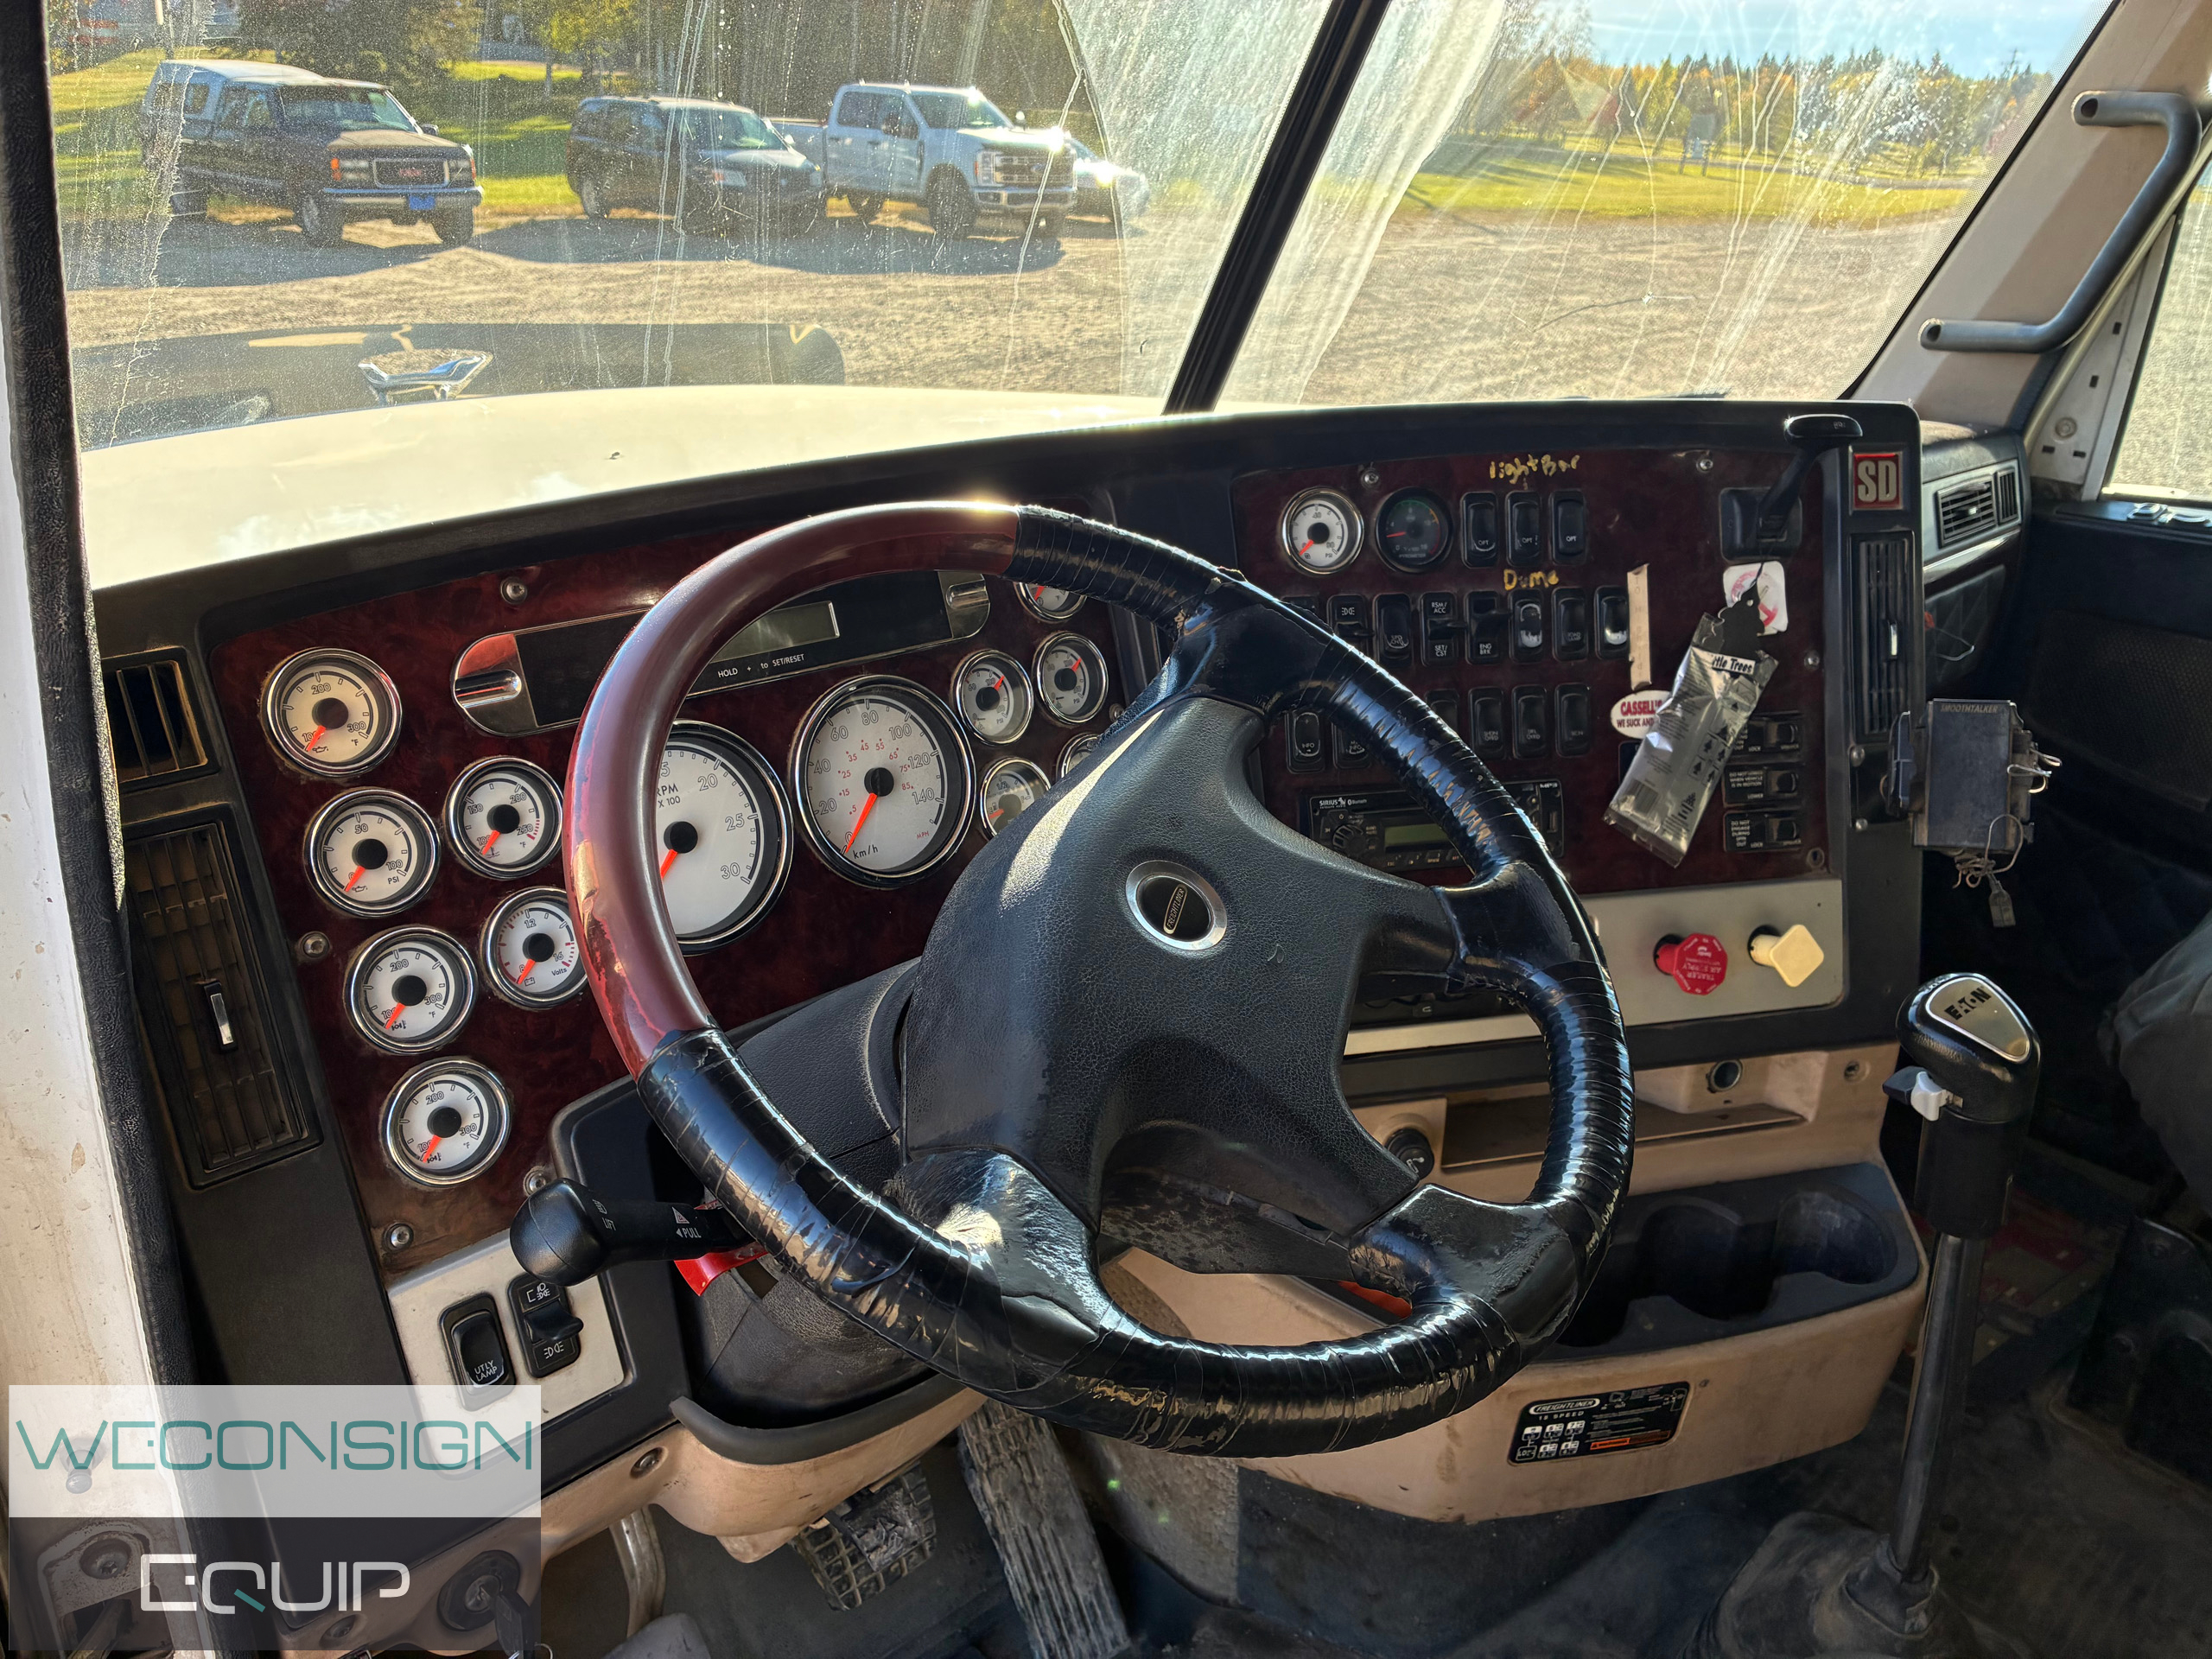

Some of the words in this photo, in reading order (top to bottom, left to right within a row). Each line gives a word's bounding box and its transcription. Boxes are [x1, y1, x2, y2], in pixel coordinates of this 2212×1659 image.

[1857, 460, 1897, 503] SD
[717, 667, 738, 677] HOLD
[772, 653, 804, 667] SET/RESET
[1731, 658, 1752, 673] Trees
[311, 683, 332, 695] 200
[861, 709, 879, 726] 80
[1617, 718, 1625, 728] WE
[1626, 718, 1641, 728] SUCK
[346, 721, 366, 733] 300
[830, 725, 849, 741] 60
[888, 723, 912, 741] 100
[861, 742, 869, 751] 45
[875, 742, 885, 751] 55
[848, 753, 857, 762] 35
[889, 751, 899, 760] 65
[907, 752, 931, 769] 120
[659, 761, 671, 777] 5
[813, 758, 831, 775] 40
[842, 770, 851, 779] 25
[697, 773, 718, 791] 20
[509, 791, 526, 804] 200
[842, 788, 850, 797] 15
[912, 787, 935, 804] 140
[666, 795, 681, 806] 100
[818, 798, 837, 815] 20
[467, 804, 484, 815] 150
[354, 823, 369, 834] 50
[725, 813, 745, 831] 25
[517, 823, 533, 836] 250
[916, 830, 930, 840] MPH
[852, 844, 880, 860] km/h
[385, 859, 403, 871] 100
[720, 862, 741, 880] 30
[387, 876, 399, 885] PSI
[1166, 888, 1185, 929] FREIGHTLINER
[524, 918, 537, 929] 12
[553, 951, 563, 962] 16
[390, 958, 410, 972] 200
[551, 968, 568, 976] Volts
[423, 993, 442, 1006] 300
[1944, 986, 1992, 1020] EATON
[425, 1090, 445, 1105] 200
[459, 1122, 477, 1136] 300
[601, 1217, 616, 1231] LIFT
[682, 1227, 702, 1238] PULL
[474, 1359, 493, 1374] UTLY
[475, 1366, 498, 1382] LAMP
[1535, 1399, 1595, 1413] FREIGHTLINER
[1553, 1410, 1585, 1420] SPEED
